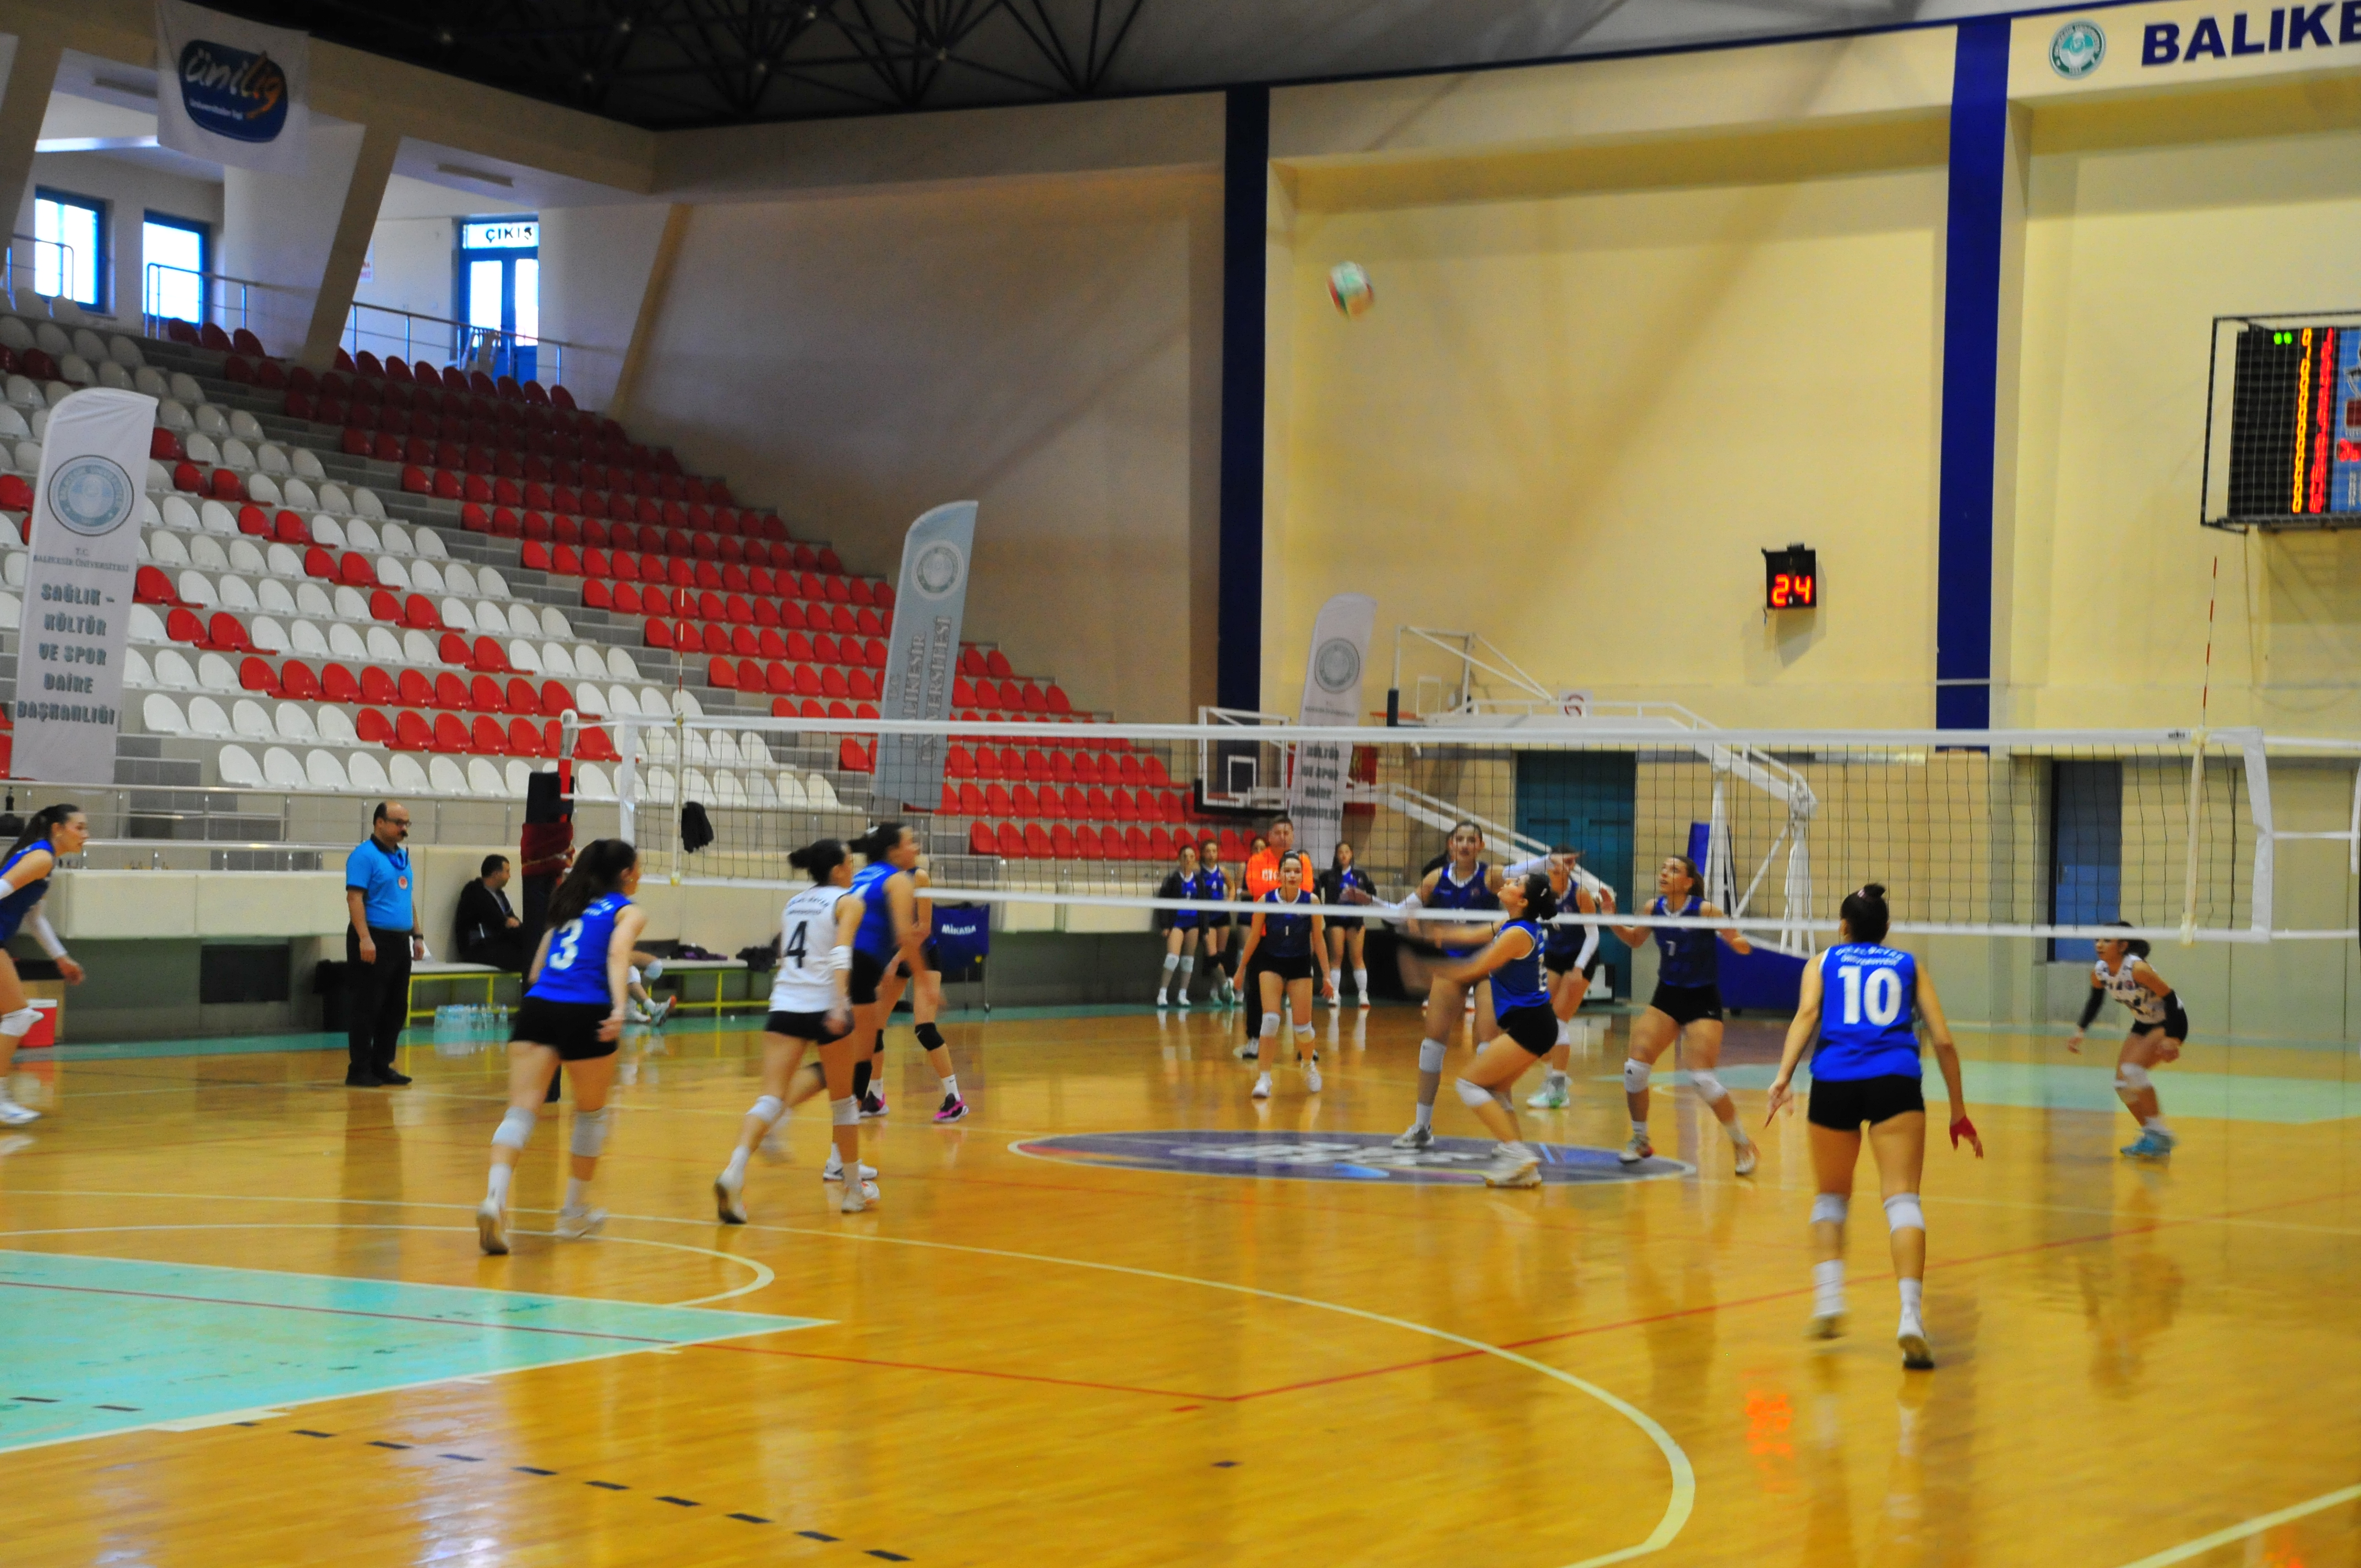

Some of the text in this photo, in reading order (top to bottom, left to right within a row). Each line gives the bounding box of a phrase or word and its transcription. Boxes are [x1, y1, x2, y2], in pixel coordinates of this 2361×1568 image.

[41, 582, 100, 606] SAĞLIK
[1772, 574, 1811, 607] 24
[44, 612, 106, 636] KÜLTÜR
[39, 643, 106, 665] VE SPOR
[44, 672, 93, 693] DAİRE
[17, 700, 115, 725] BAŞKANLIĞI
[550, 918, 584, 971] 3
[787, 921, 808, 969] 4
[1666, 940, 1677, 956] 7
[1837, 965, 1902, 1027] 10
